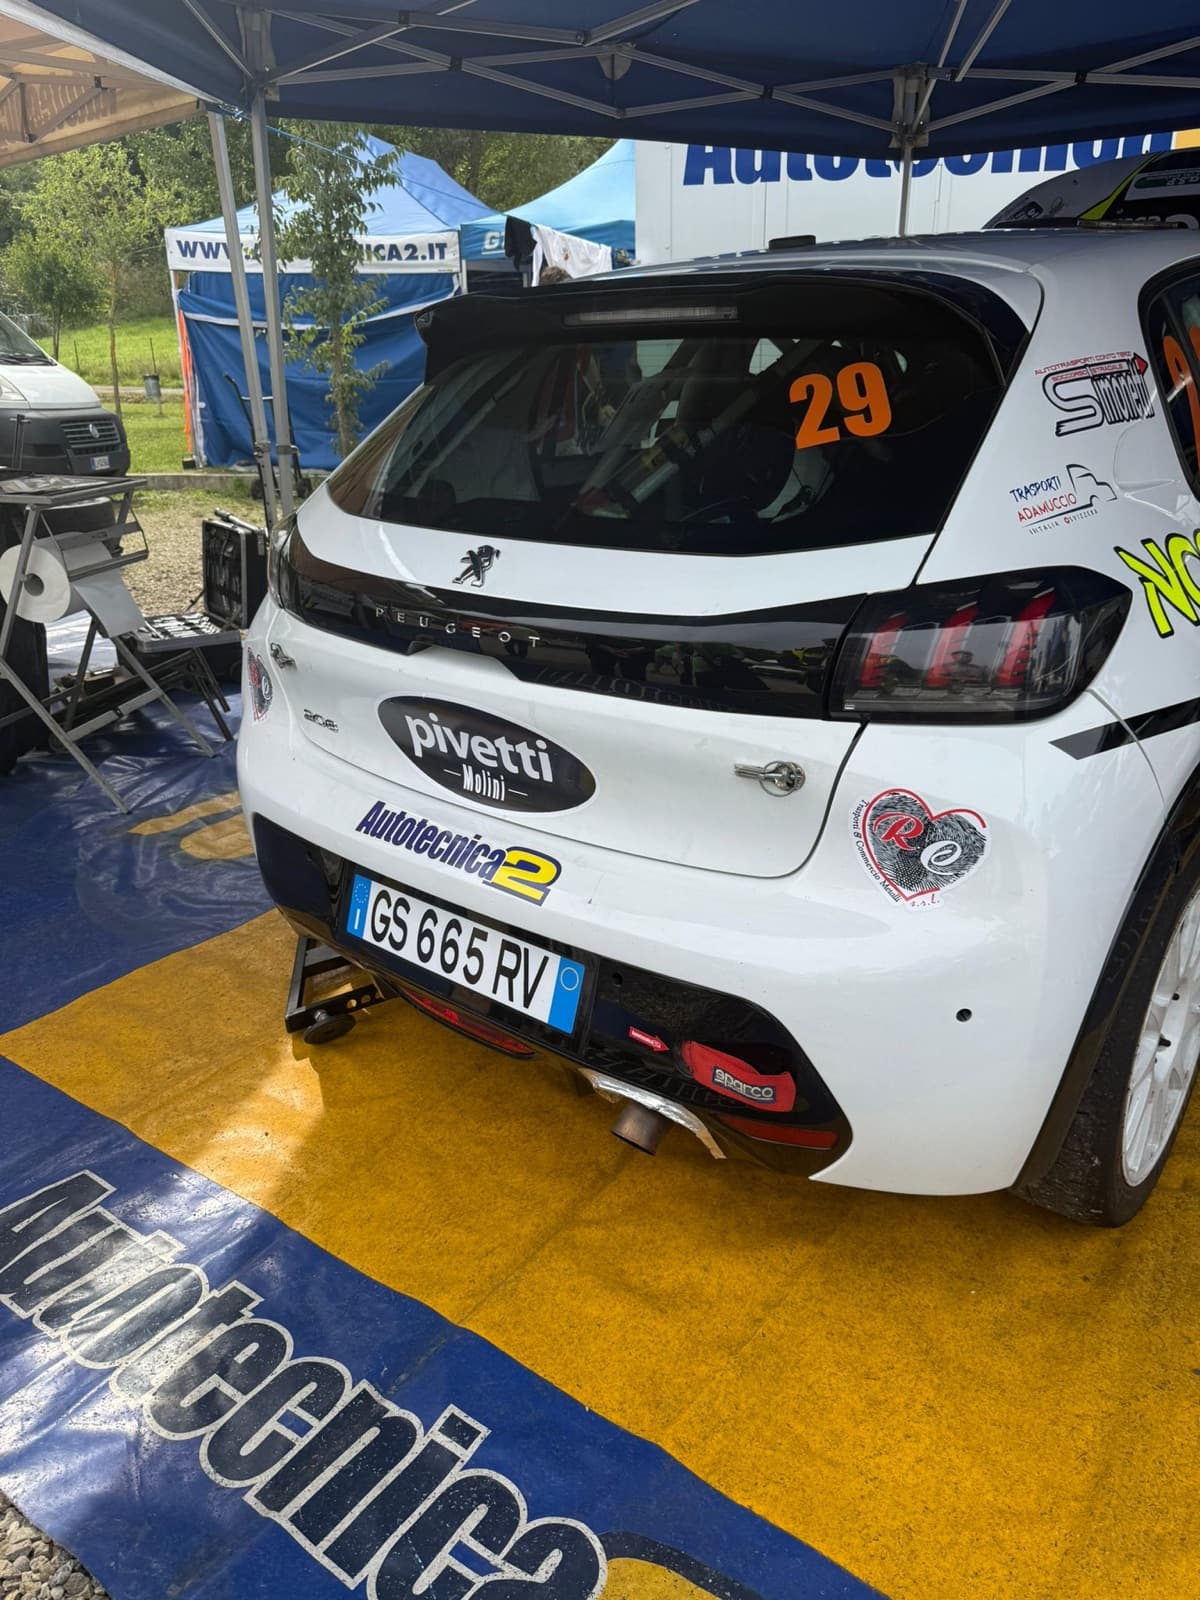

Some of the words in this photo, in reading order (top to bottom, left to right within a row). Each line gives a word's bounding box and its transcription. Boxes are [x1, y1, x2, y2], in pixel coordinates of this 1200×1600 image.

[789, 362, 892, 449] 29
[1009, 475, 1062, 502] TRASPORTI
[1017, 493, 1077, 522] ADAMUCCIO
[375, 607, 541, 648] PEUGEOT
[405, 712, 553, 783] pivetti
[462, 763, 505, 801] Molini
[855, 840, 881, 881] Commercio
[370, 889, 411, 951] GS
[416, 908, 489, 985] 665
[491, 938, 549, 1009] RV
[714, 1067, 774, 1099] sparco
